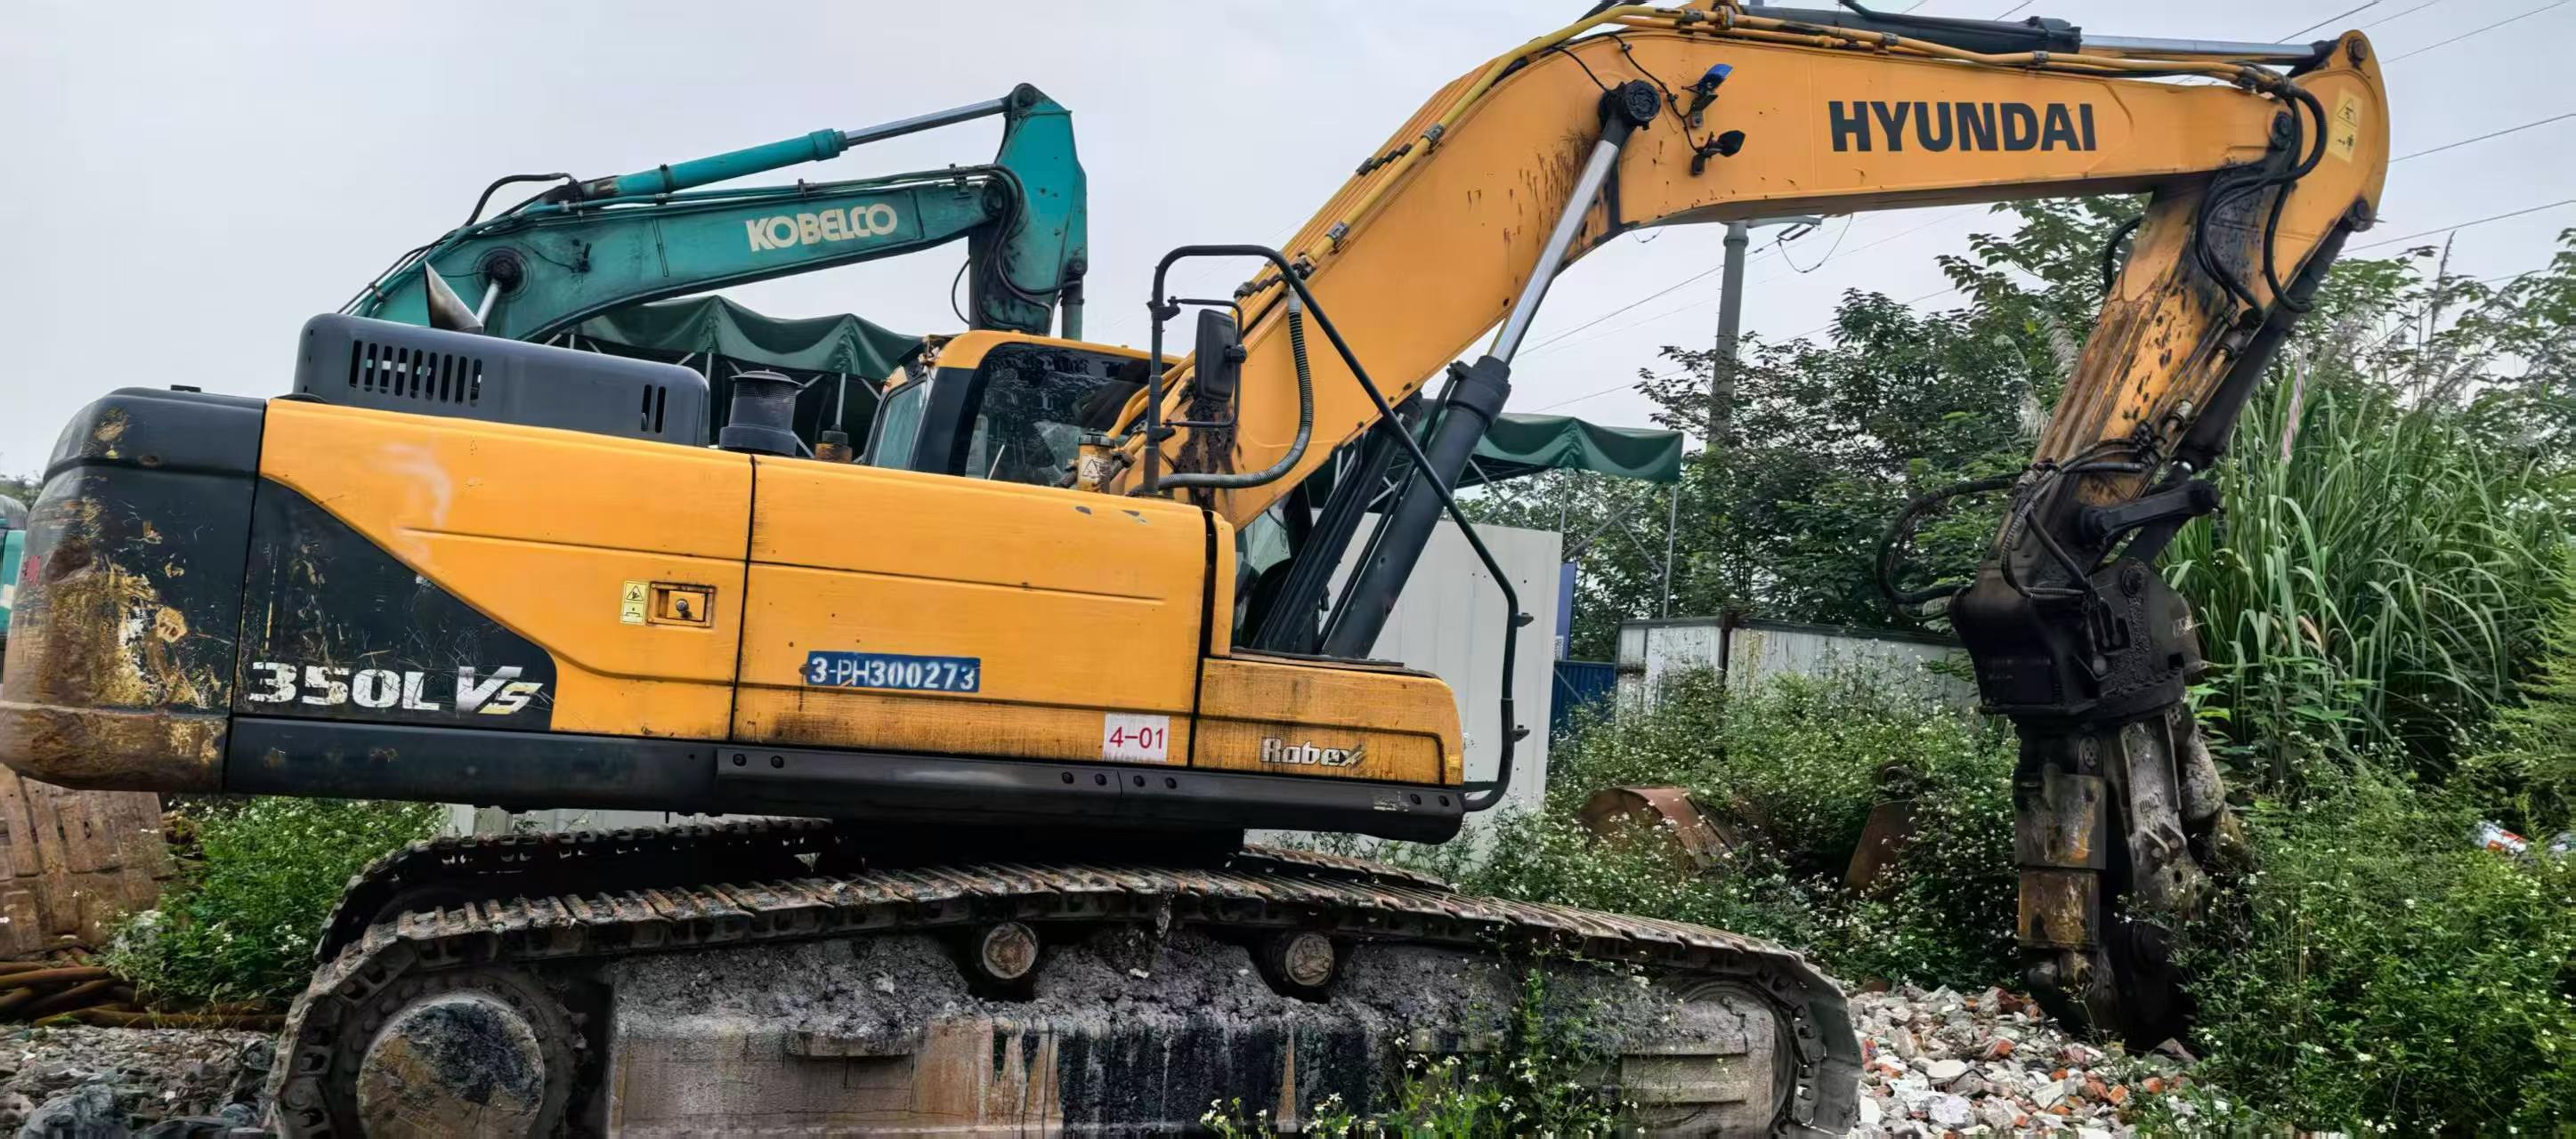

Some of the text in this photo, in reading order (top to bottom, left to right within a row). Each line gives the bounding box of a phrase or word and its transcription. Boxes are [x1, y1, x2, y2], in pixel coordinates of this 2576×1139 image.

[1828, 101, 2097, 152] HYUNDAI
[746, 203, 898, 252] KOBELCO
[811, 657, 976, 691] 3-PH300273
[1109, 725, 1164, 749] 4-01
[1260, 736, 1365, 768] Robex
